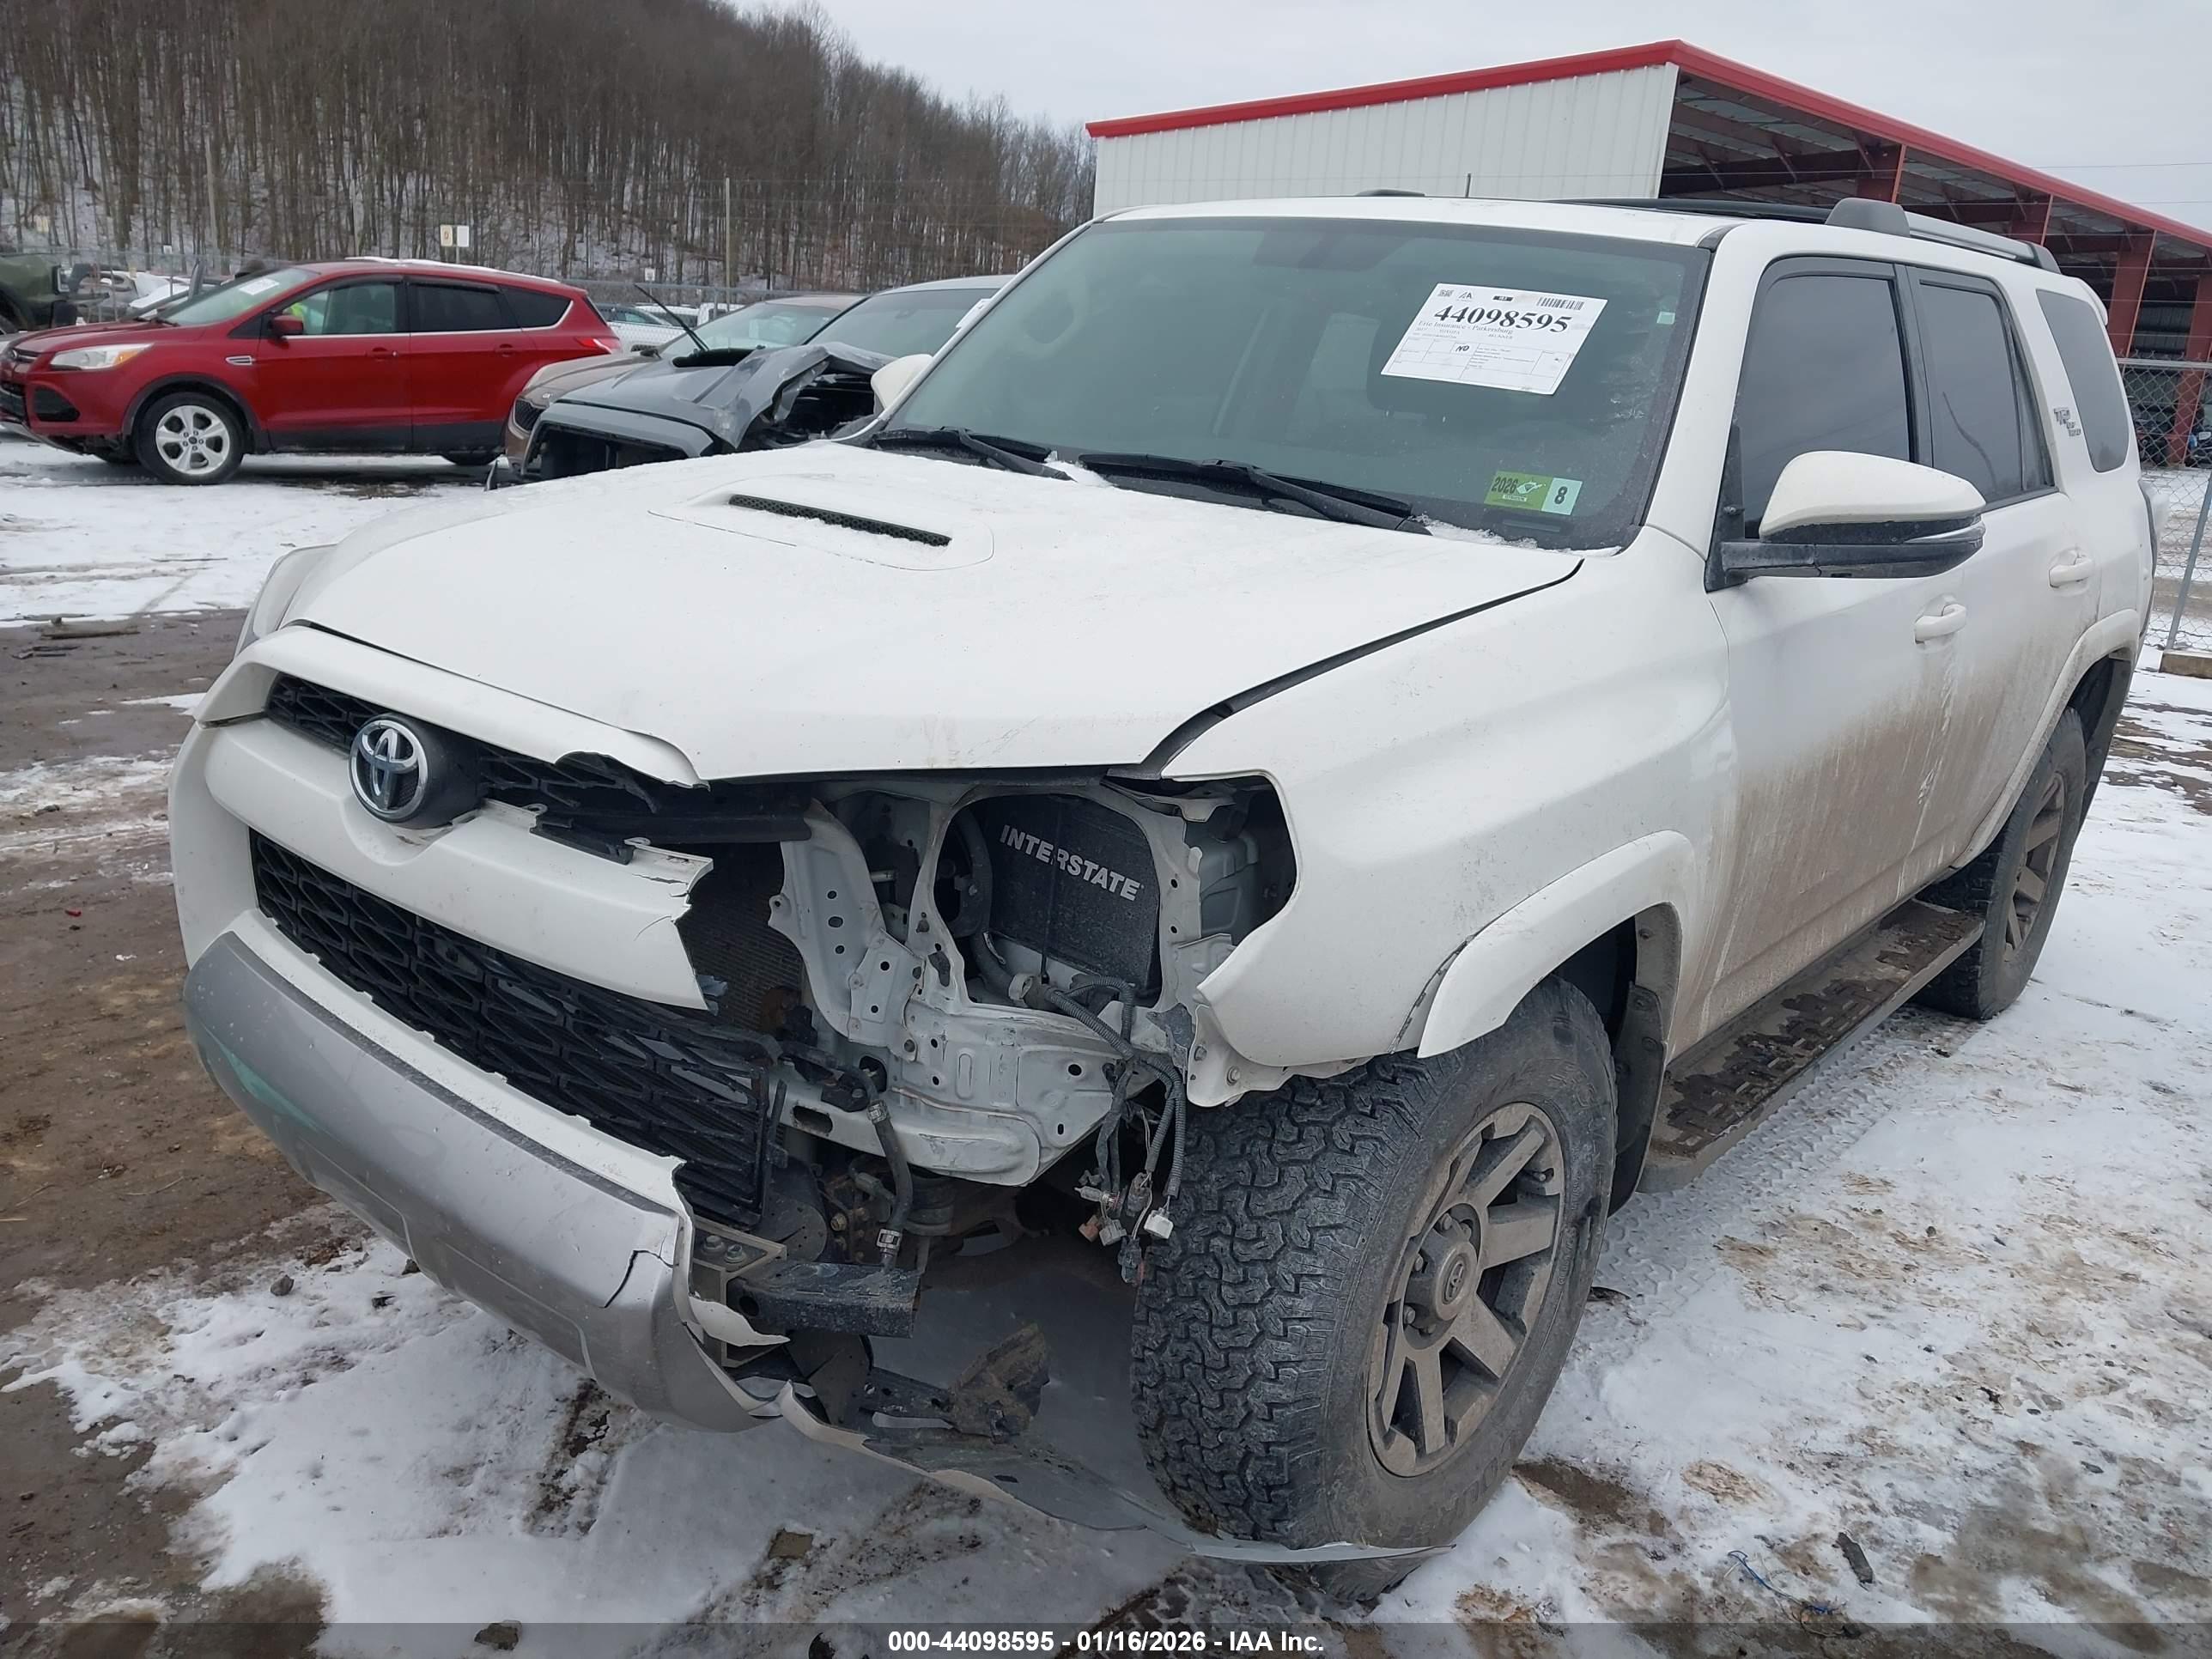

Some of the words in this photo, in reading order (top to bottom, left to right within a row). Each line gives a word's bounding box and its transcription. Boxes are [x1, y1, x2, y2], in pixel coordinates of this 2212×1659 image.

[1434, 305, 1573, 333] 44098595
[1434, 321, 1466, 330] Insurance
[1472, 325, 1514, 335] Parkersburg
[1492, 477, 1519, 495] 2026
[1554, 486, 1568, 505] 8
[1000, 824, 1143, 902] INTERSTATE
